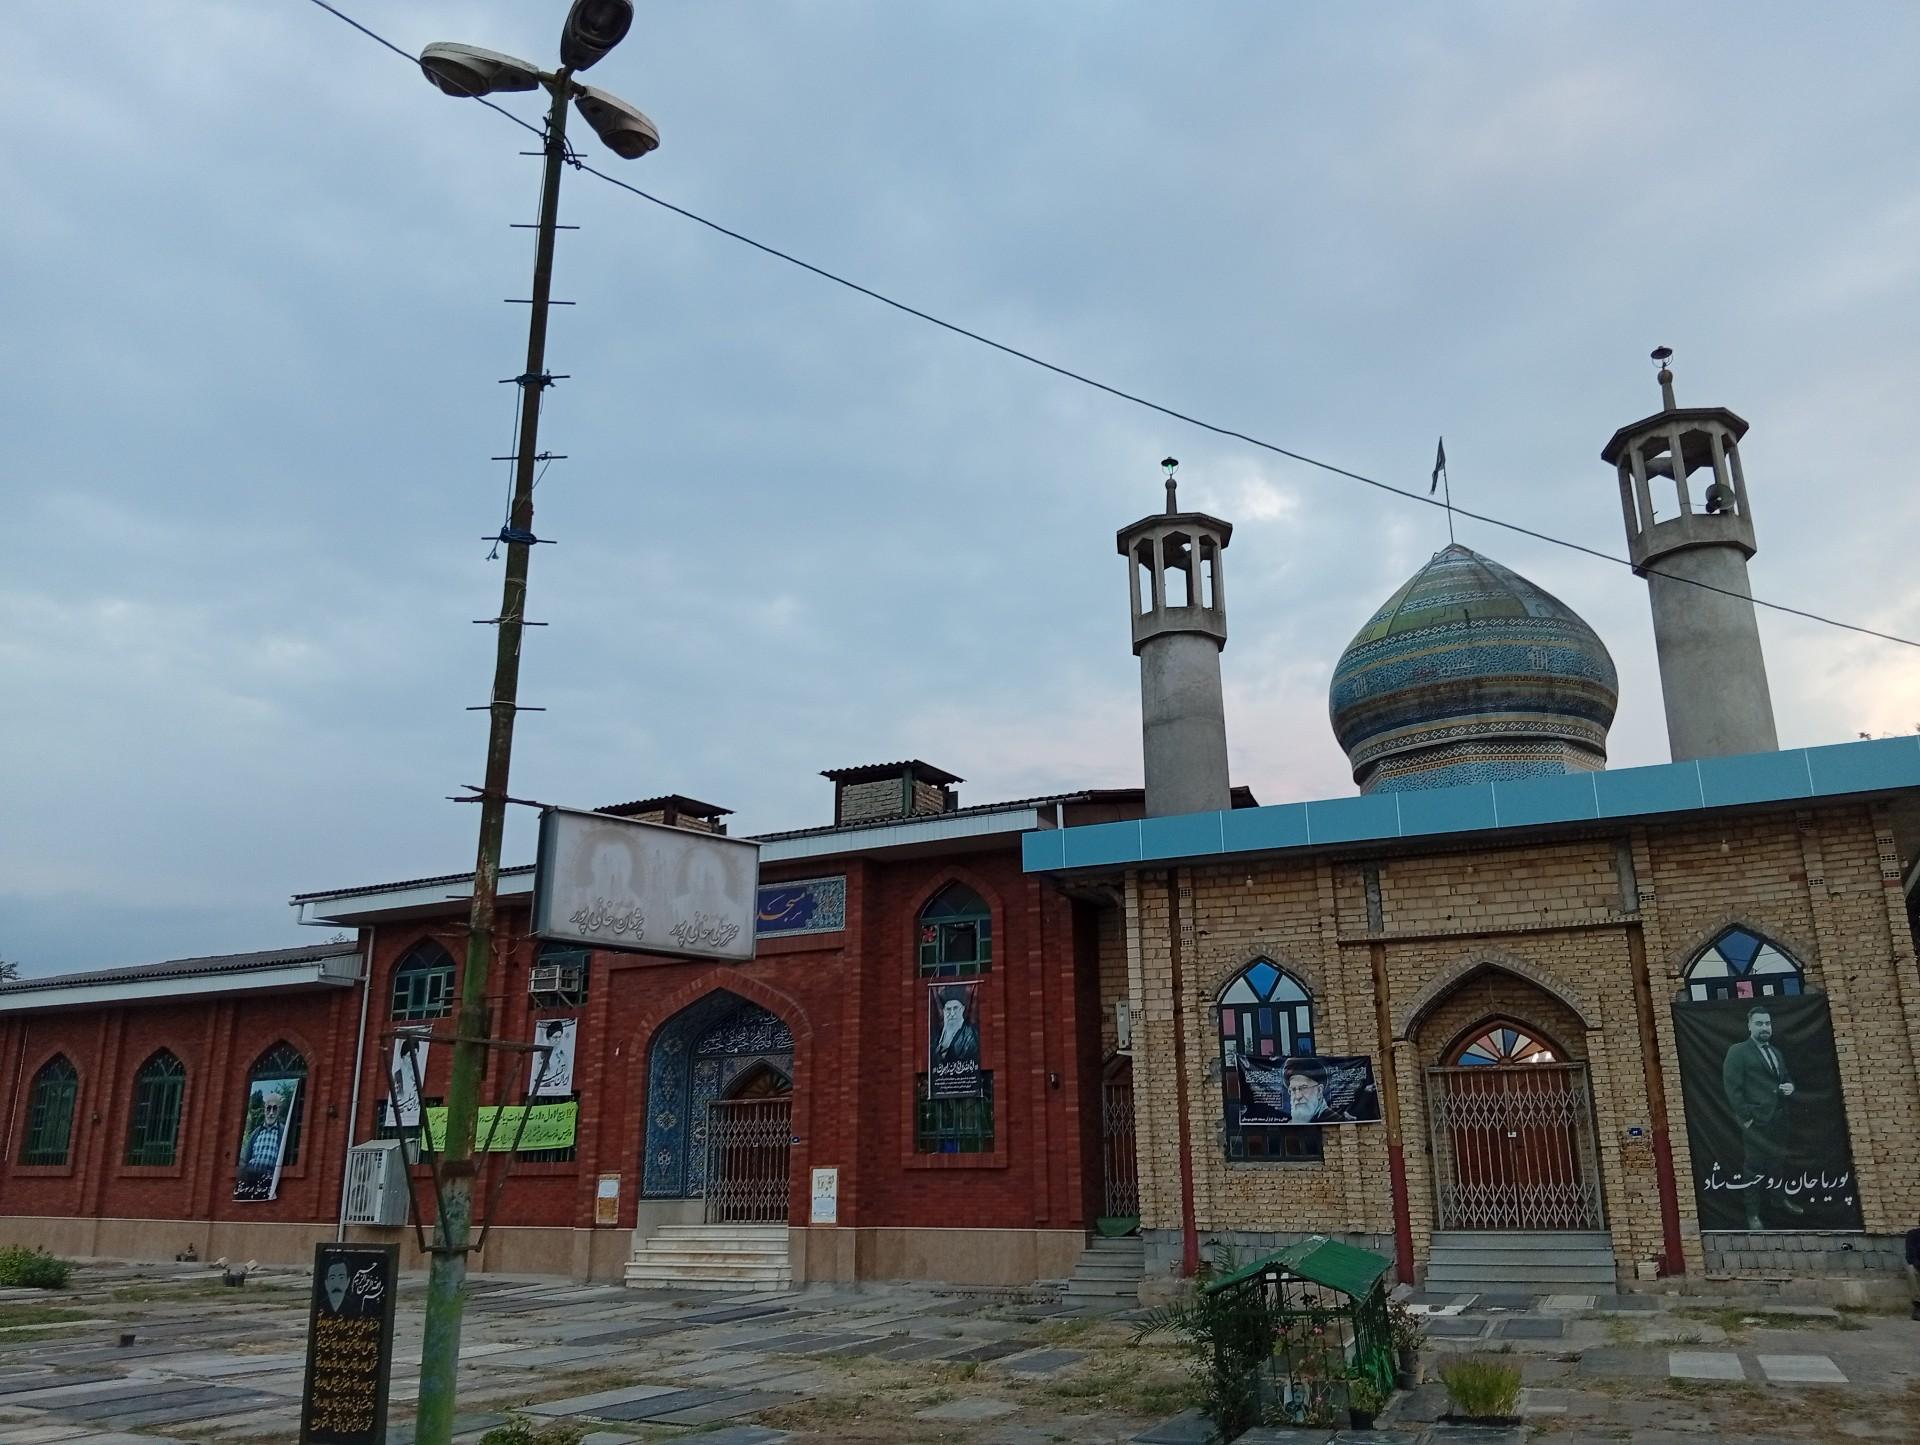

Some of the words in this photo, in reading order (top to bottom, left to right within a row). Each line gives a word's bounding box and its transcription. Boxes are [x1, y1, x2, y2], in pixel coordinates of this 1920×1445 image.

[569, 907, 590, 934] پور
[613, 907, 645, 940] پژمان
[669, 920, 687, 947] پور
[1703, 1161, 1727, 1191] شاد
[1725, 1171, 1783, 1190] روحت
[1784, 1170, 1819, 1203] جان
[1821, 1169, 1853, 1206] پوریا
[361, 1285, 385, 1312] بسم
